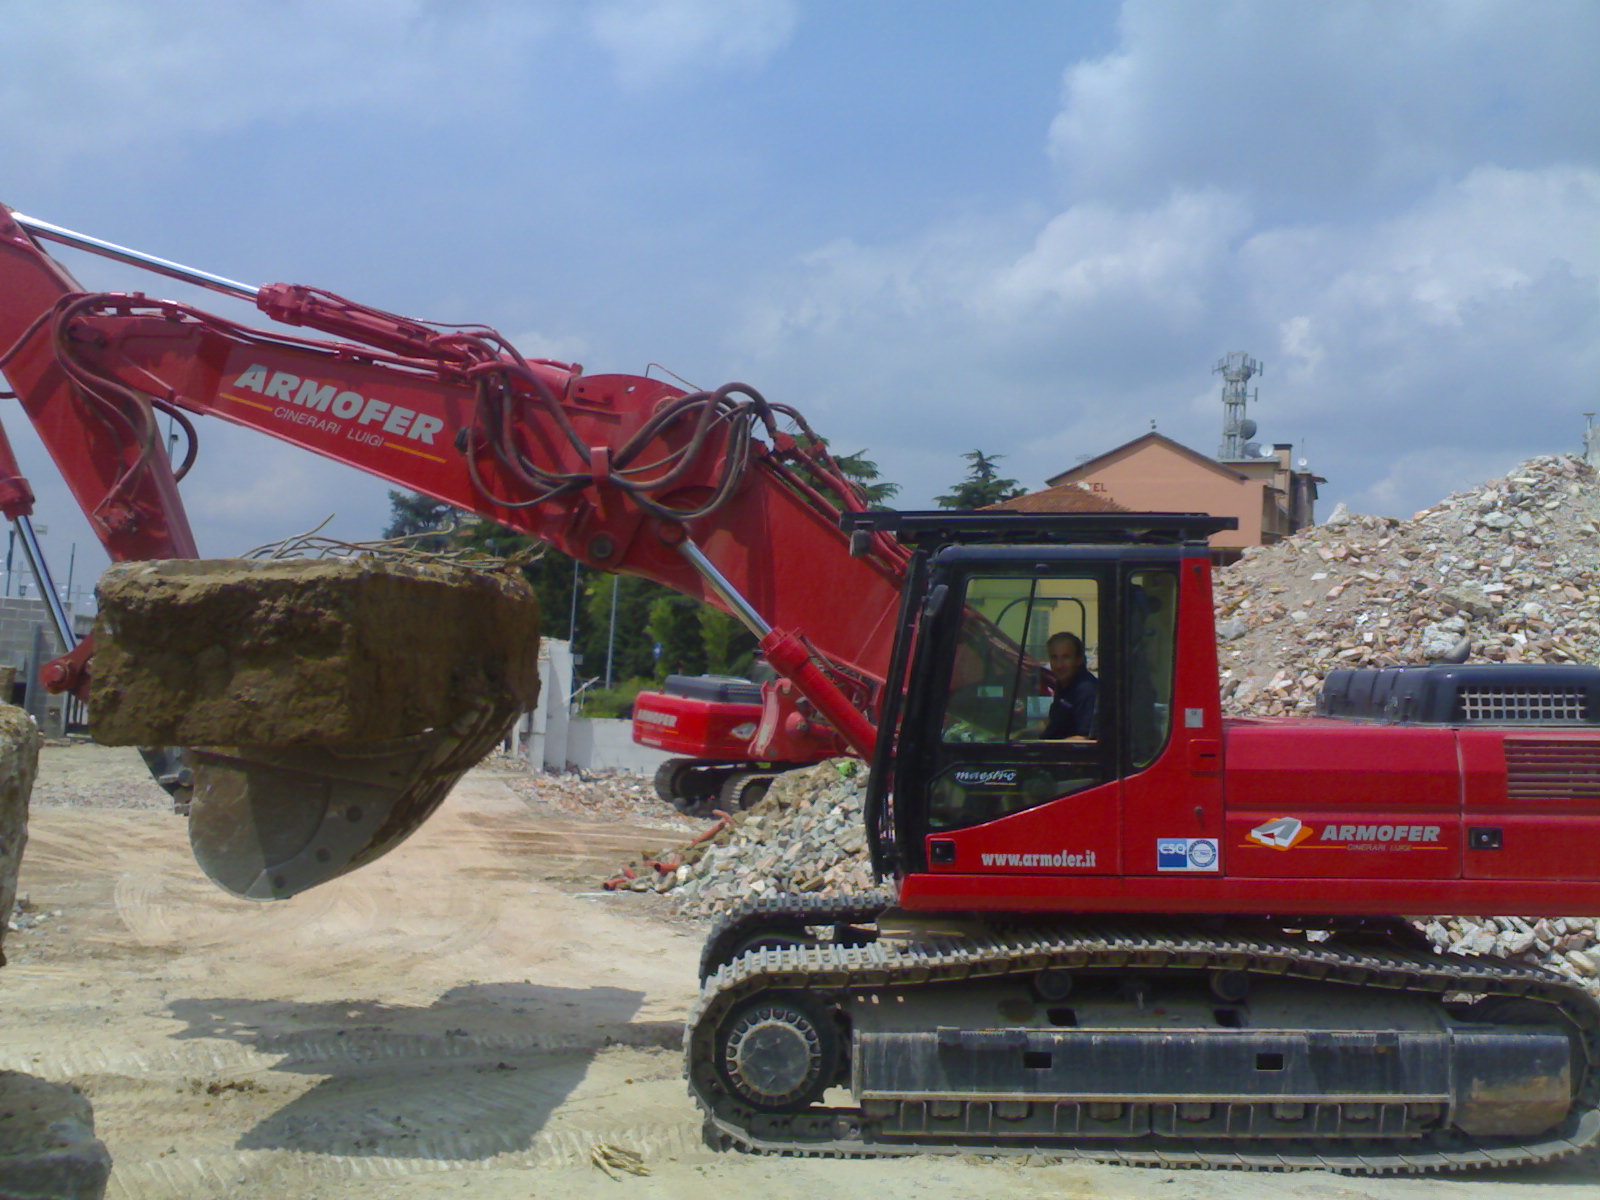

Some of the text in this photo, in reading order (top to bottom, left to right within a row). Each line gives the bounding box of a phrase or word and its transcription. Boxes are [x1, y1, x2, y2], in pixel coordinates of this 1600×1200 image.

[233, 363, 444, 445] ARMOFER
[273, 406, 385, 448] CINERARI LUIGI
[954, 769, 1017, 785] maestro
[1320, 824, 1441, 842] ARMOFER
[981, 849, 1097, 867] www.armofer.it
